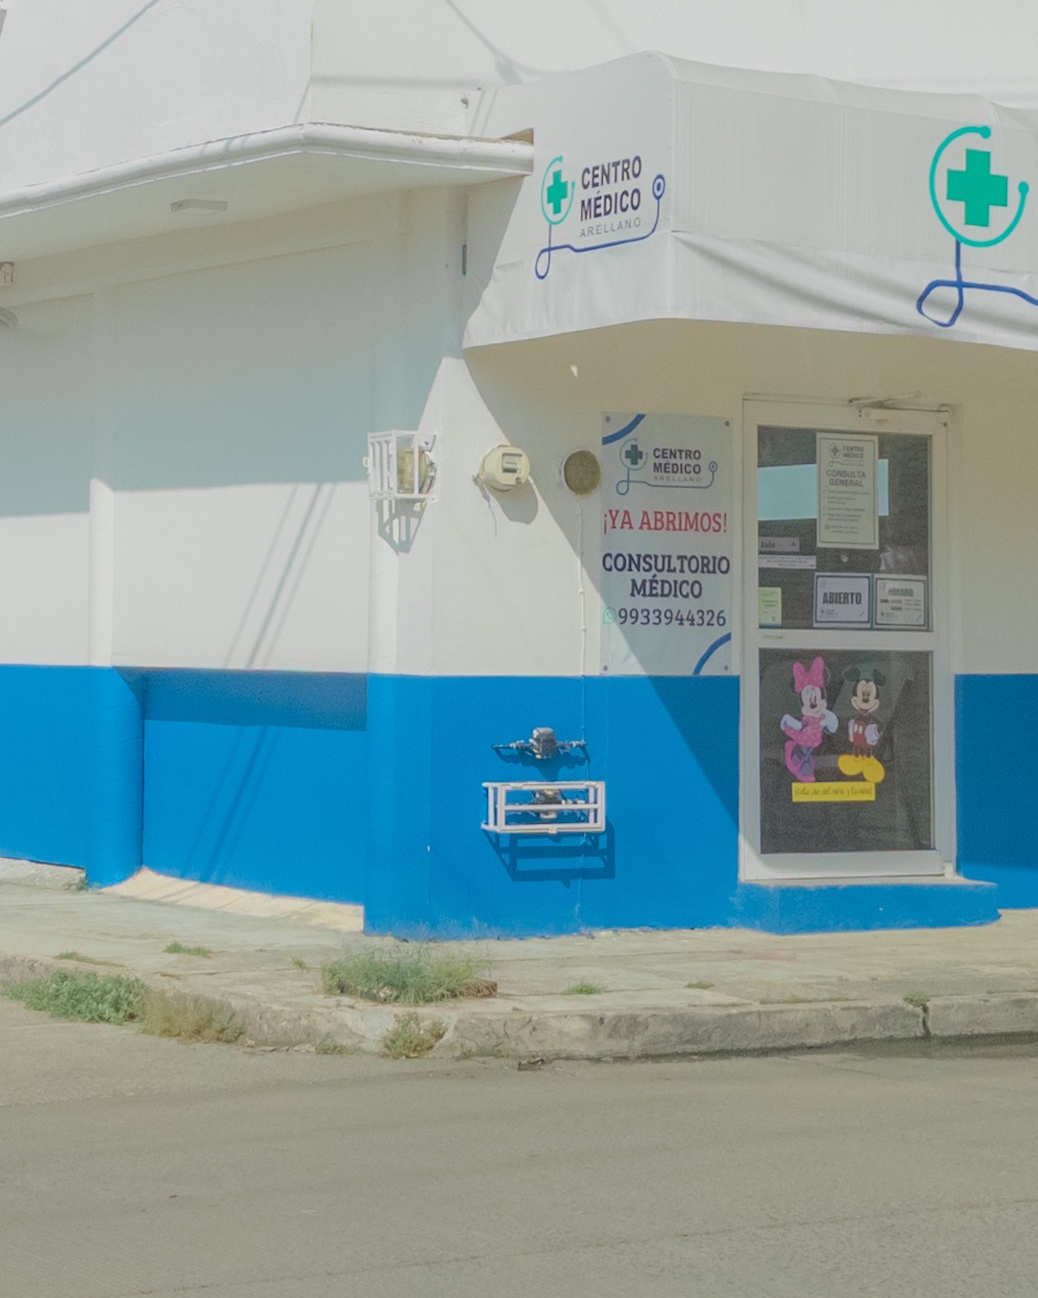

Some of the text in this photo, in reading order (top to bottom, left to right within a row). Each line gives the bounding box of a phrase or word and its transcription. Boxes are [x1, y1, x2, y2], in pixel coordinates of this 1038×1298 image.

[581, 155, 643, 190] CENTRO
[580, 188, 642, 222] MÉDICO
[579, 217, 642, 238] ARELLANO
[653, 448, 702, 460] CENTRO
[653, 461, 702, 475] MÉDICO
[826, 469, 867, 479] CONSULTA
[604, 509, 727, 534] ¡YA ABRIMOS!
[602, 552, 731, 574] CONSULTORIO
[630, 573, 703, 599] MÉDICO
[822, 592, 863, 605] ABIERTO
[618, 608, 727, 627] 9933944326
